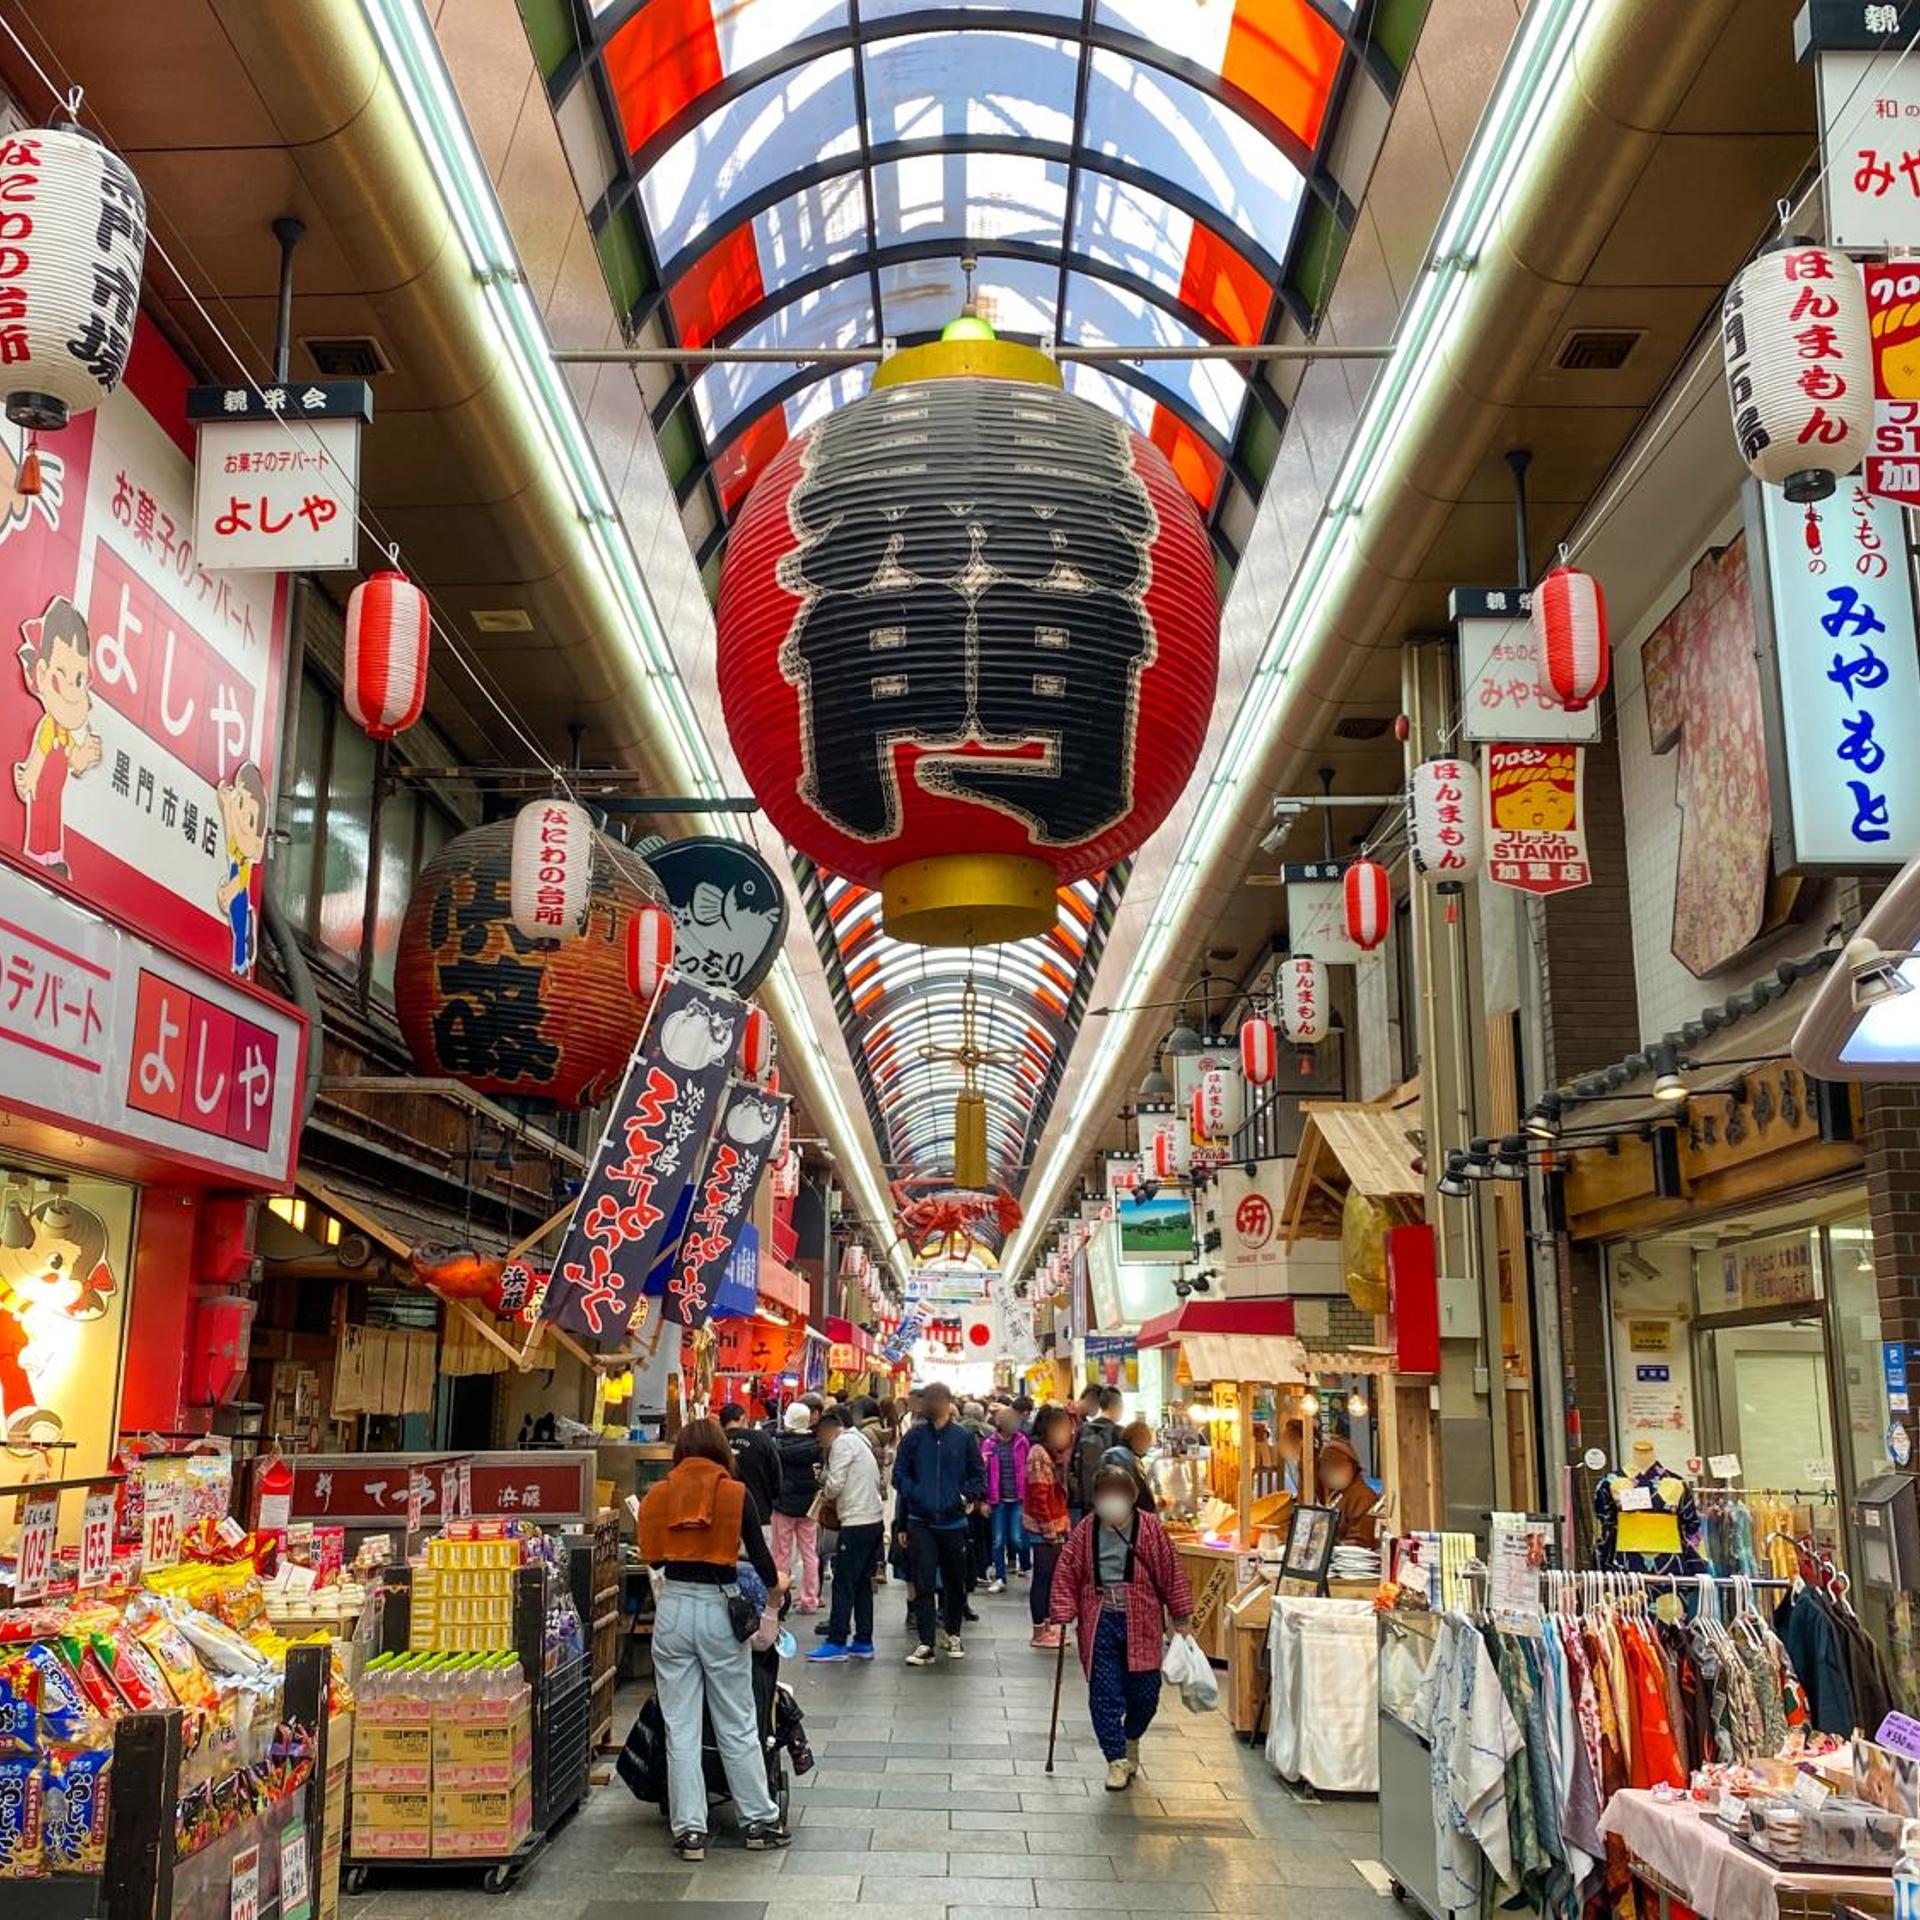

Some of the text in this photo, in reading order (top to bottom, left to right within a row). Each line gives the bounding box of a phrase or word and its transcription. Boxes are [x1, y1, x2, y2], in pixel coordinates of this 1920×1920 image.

[1865, 4, 1900, 33] 親
[1782, 250, 1849, 445] ほんまもん
[224, 386, 328, 412] 親栄会
[224, 450, 330, 474] お菓子のデパート
[214, 494, 338, 536] よしや
[1852, 486, 1888, 578] きもの
[777, 380, 1161, 845] 黒門
[95, 583, 246, 779] よしや
[1821, 586, 1890, 842] みやもと
[111, 750, 219, 858] 黒門市場店
[1433, 762, 1467, 869] ほんまもん
[534, 807, 569, 926] なにわの台所
[1493, 844, 1580, 861] STAMP
[1495, 862, 1584, 881] 加盟店
[0, 951, 103, 1046] デパート
[674, 947, 745, 982] っちり
[1295, 961, 1316, 1035] ほんまもん
[139, 998, 270, 1133] よしや
[682, 1329, 739, 1349] Shi
